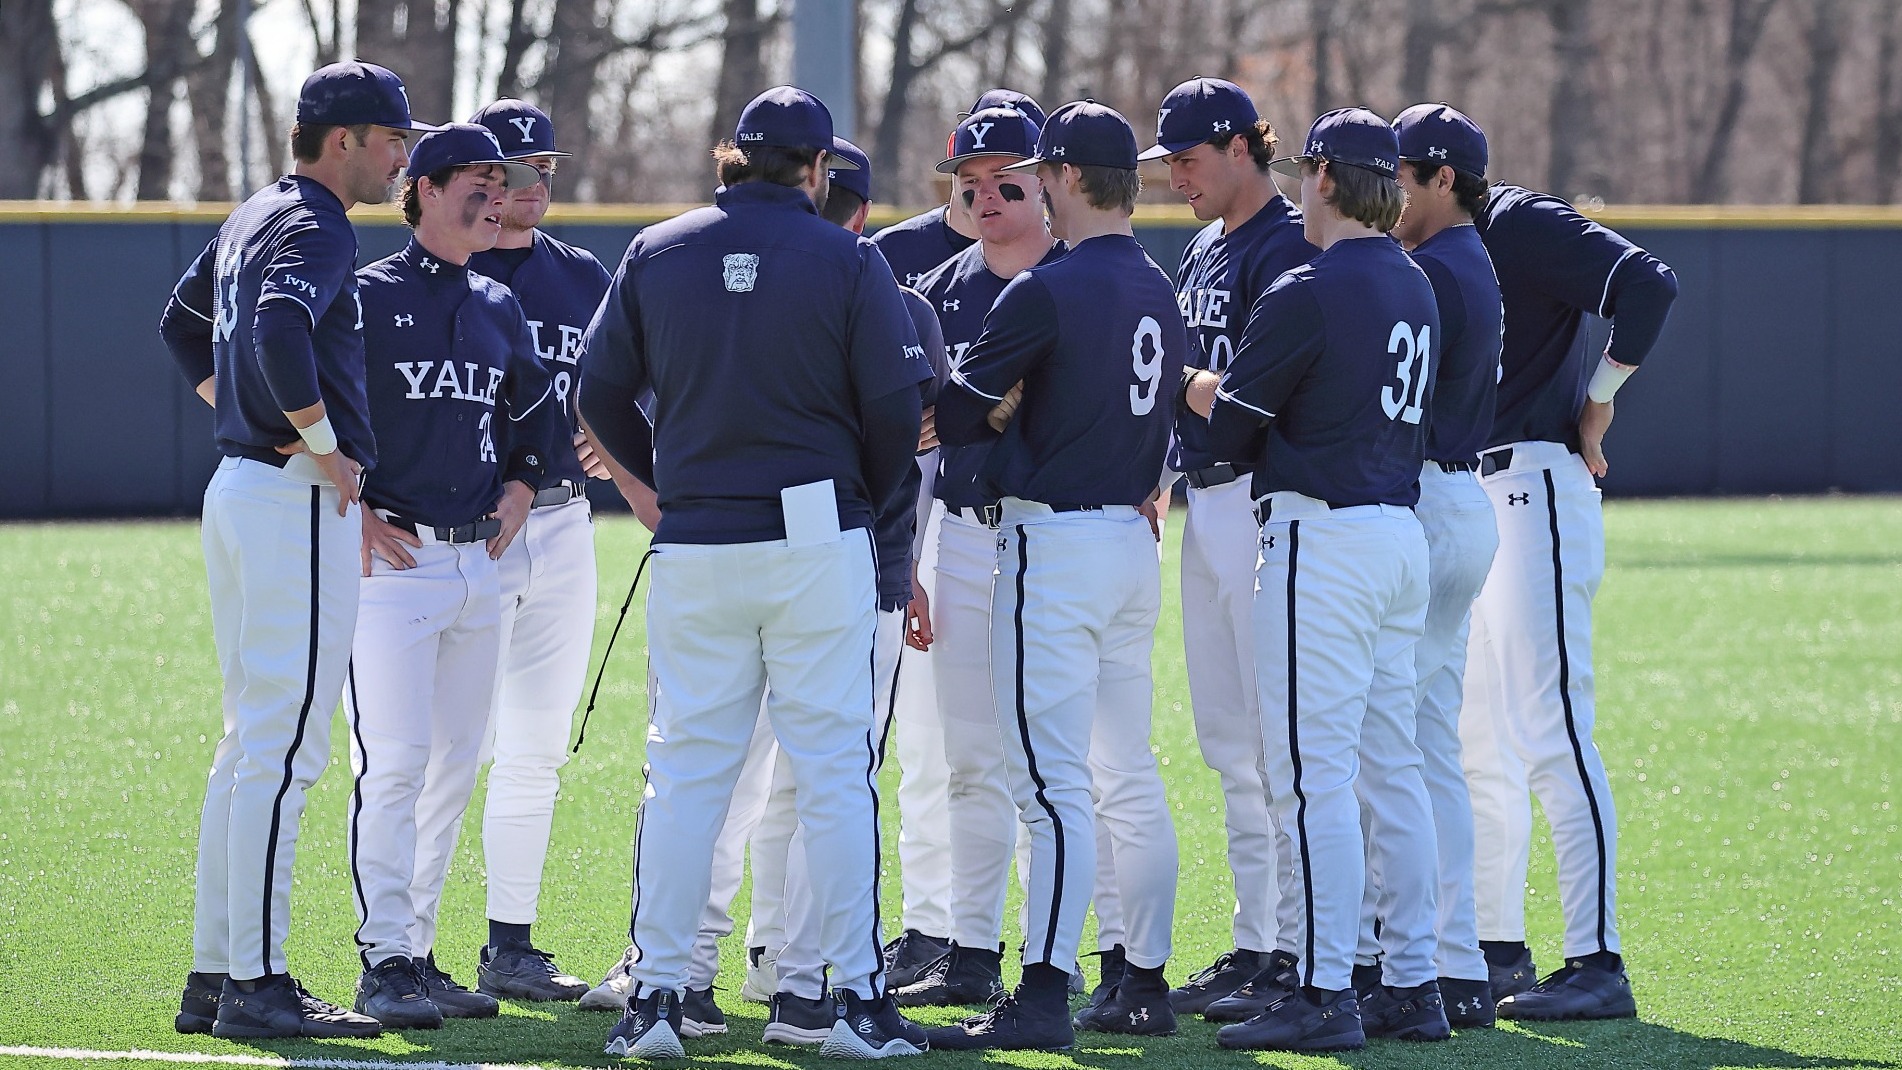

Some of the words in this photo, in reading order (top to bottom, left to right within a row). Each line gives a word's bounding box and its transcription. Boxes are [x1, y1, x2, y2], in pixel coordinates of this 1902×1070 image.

[508, 117, 537, 143] Y
[740, 132, 764, 141] YALE
[967, 122, 995, 149] Y
[1374, 157, 1395, 172] YALE
[1128, 315, 1166, 416] 9
[1380, 320, 1431, 425] 31
[394, 359, 505, 407] YALE
